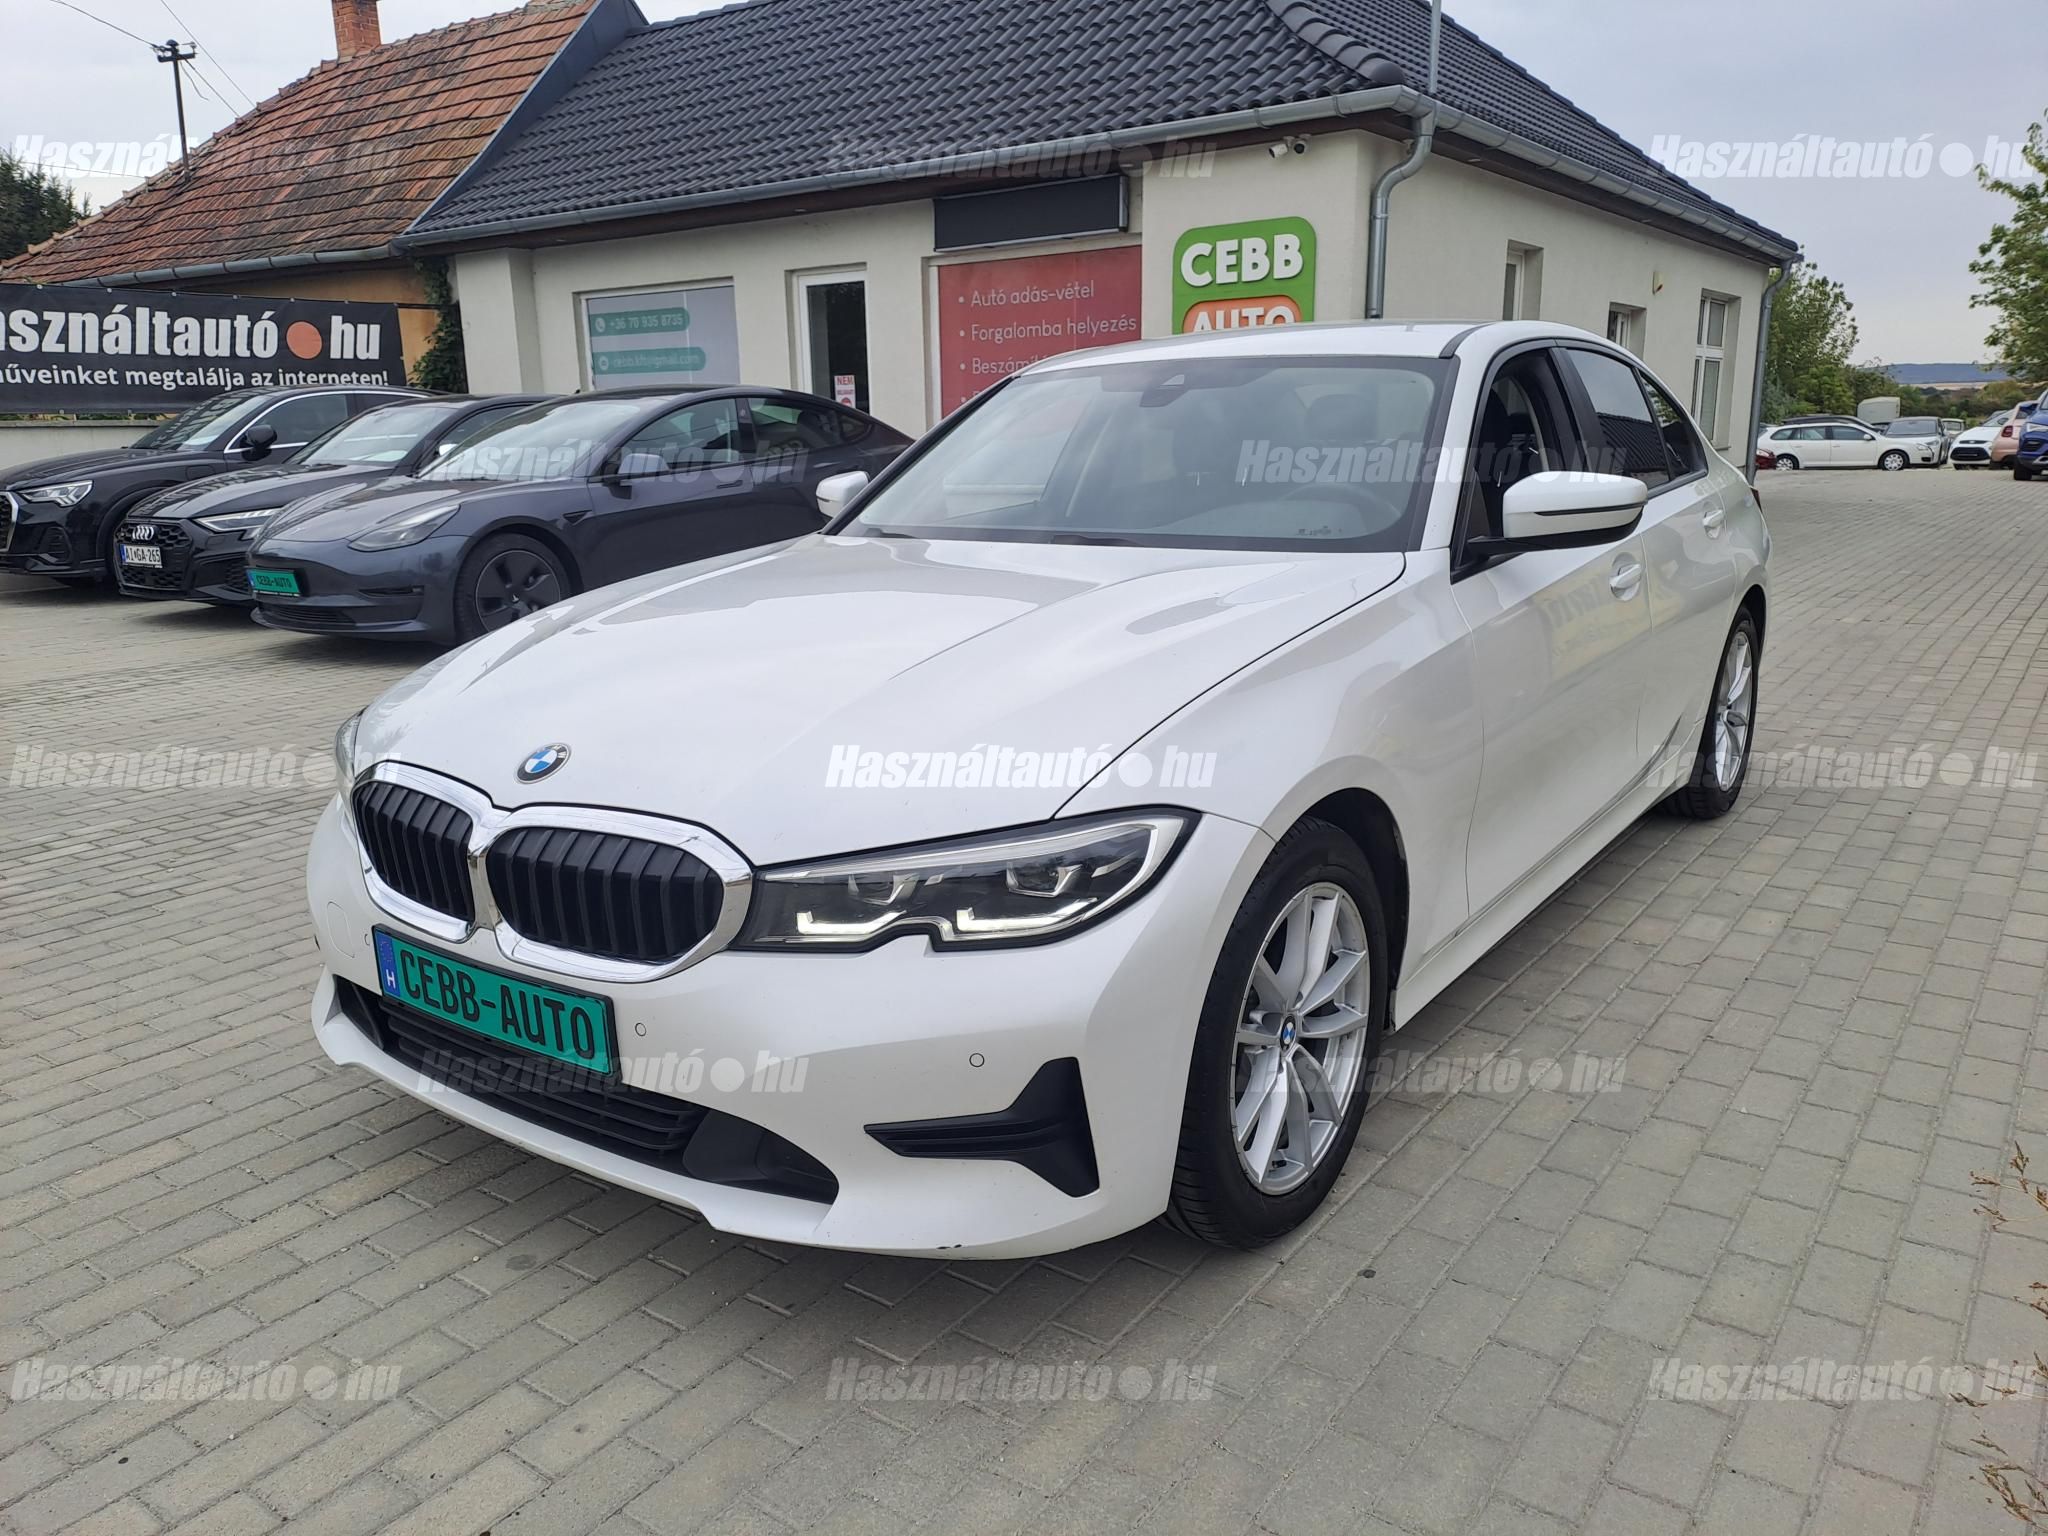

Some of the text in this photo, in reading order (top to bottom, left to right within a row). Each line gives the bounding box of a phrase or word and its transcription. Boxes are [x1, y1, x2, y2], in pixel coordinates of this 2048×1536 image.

[1181, 233, 1303, 287] CEBB
[970, 289, 1007, 308] Autó
[0, 304, 279, 359] sználtautó
[971, 314, 1137, 344] Forgalomba helyezés
[0, 363, 389, 391] űveinket megtalálja az interneten!
[386, 971, 396, 989] H
[400, 949, 596, 1060] CEBB-AUTO
